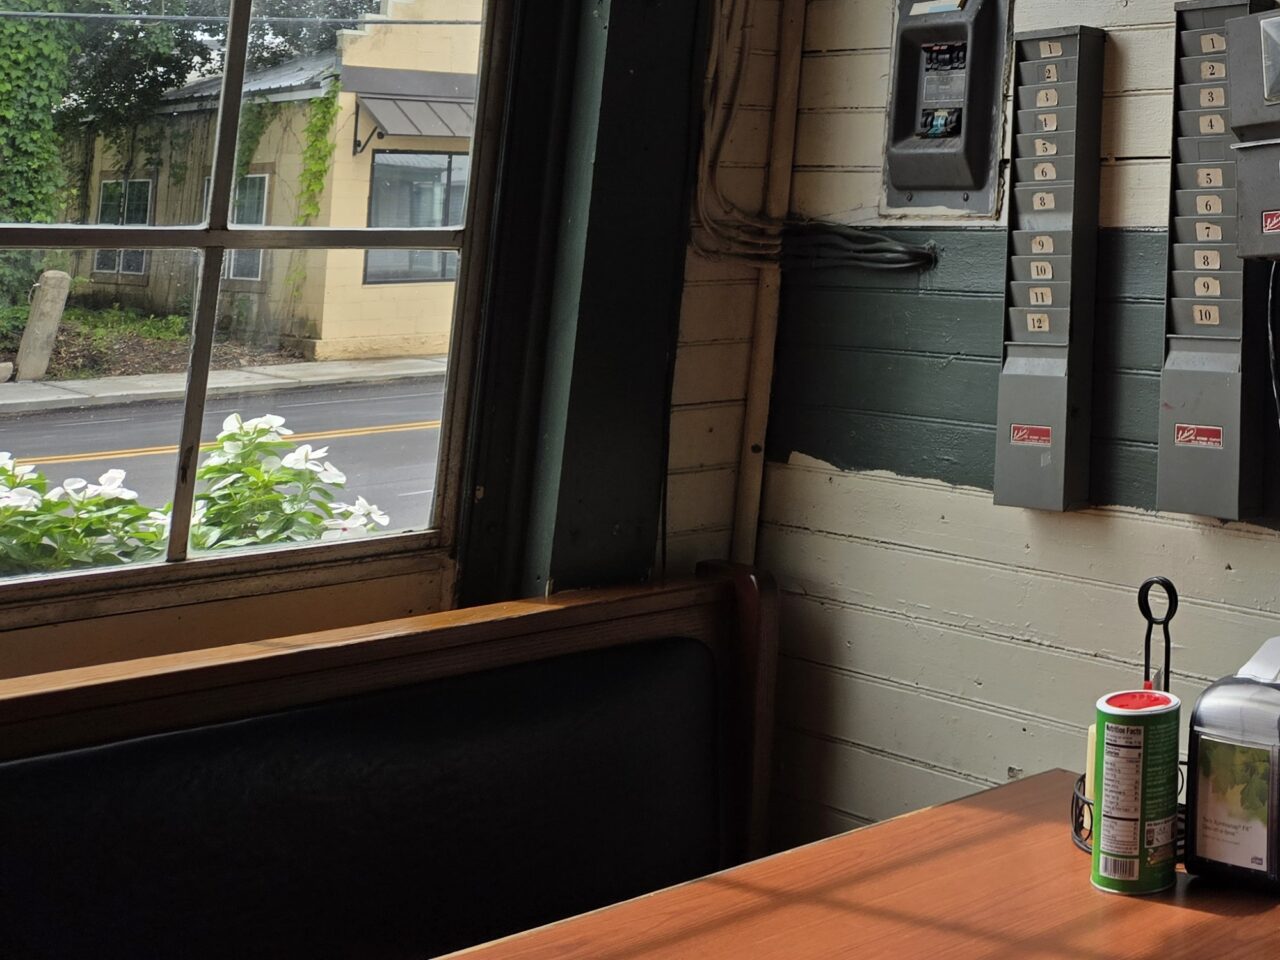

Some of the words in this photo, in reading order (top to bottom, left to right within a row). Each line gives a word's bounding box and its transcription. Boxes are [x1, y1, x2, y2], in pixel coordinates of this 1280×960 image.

[1205, 226, 1211, 238] 7
[1038, 240, 1044, 251] 9
[1203, 255, 1210, 267] 8
[1035, 265, 1046, 277] 10
[1202, 281, 1210, 293] 9
[1034, 291, 1045, 303] 11
[1198, 309, 1211, 321] 10
[1031, 318, 1042, 329] 12
[1126, 727, 1143, 735] Facts
